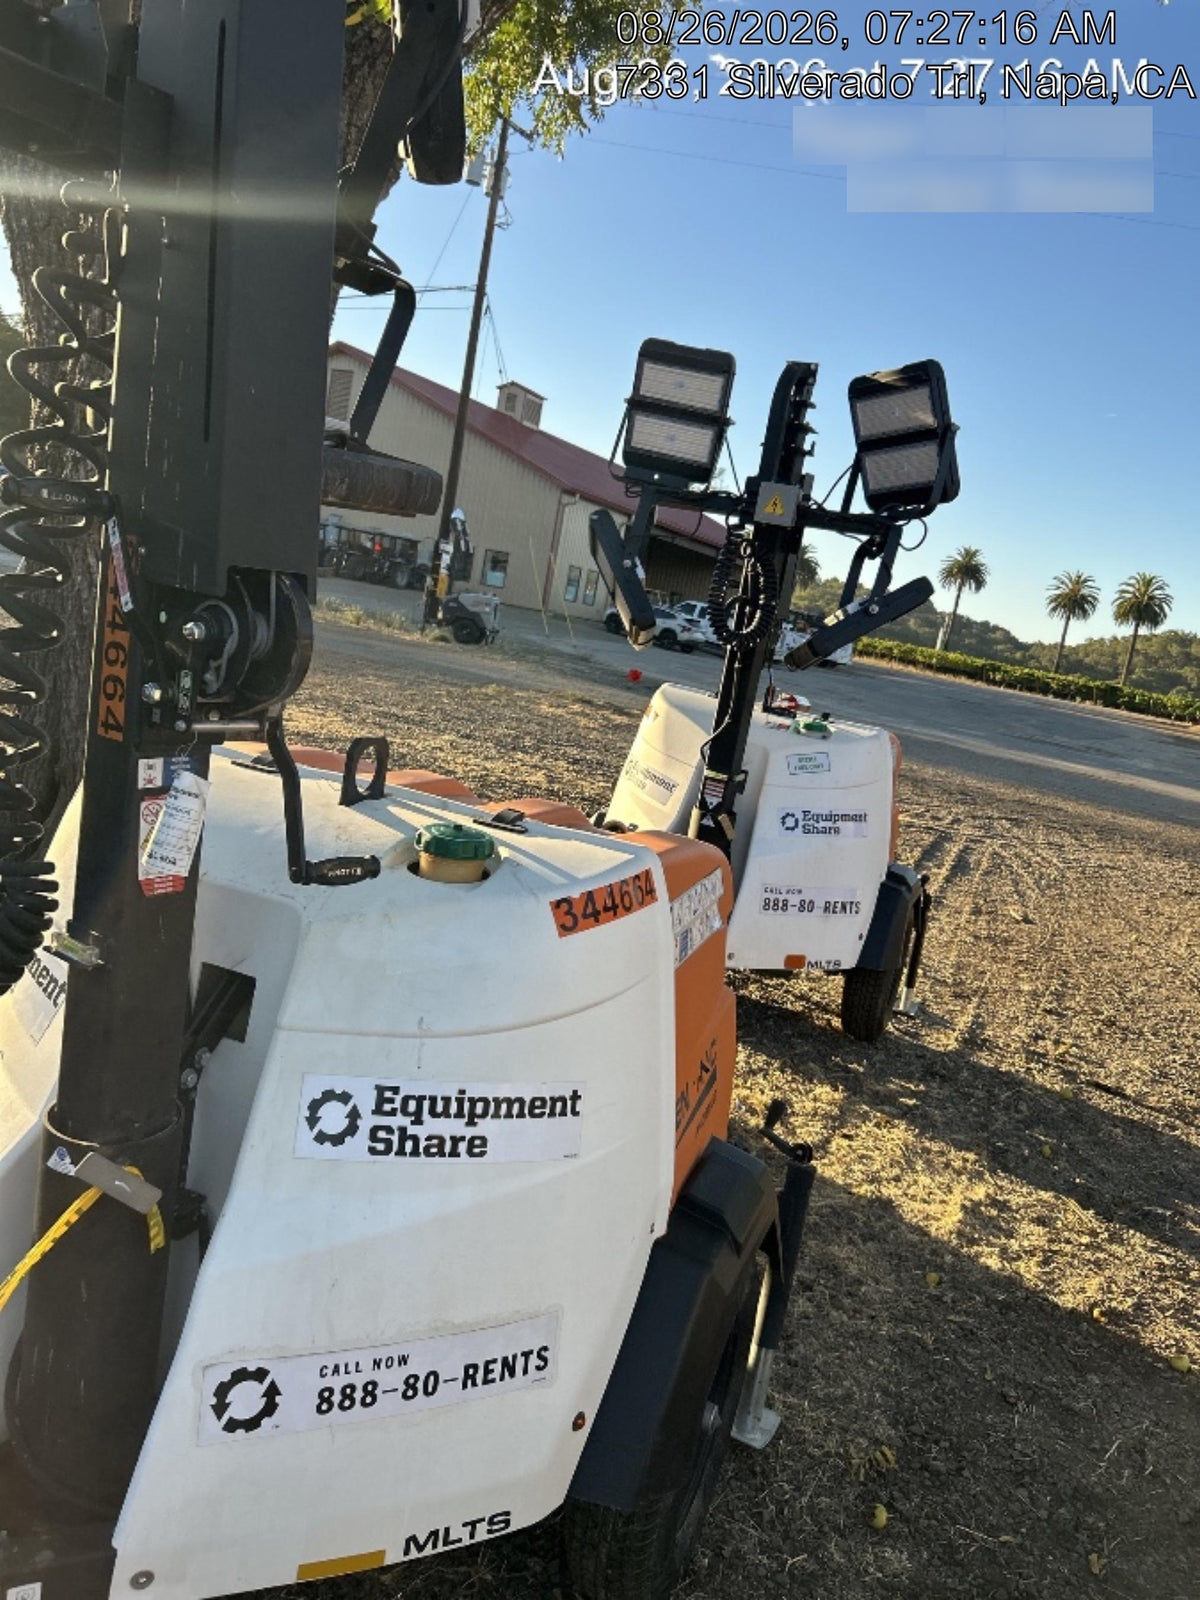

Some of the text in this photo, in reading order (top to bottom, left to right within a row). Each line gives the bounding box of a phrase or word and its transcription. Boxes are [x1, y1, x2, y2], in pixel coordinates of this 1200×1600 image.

[801, 810, 868, 826] Equipment
[802, 823, 840, 835] Share
[554, 868, 657, 932] 344664
[762, 897, 862, 915] 888-80-RENTS
[371, 1084, 582, 1127] Equipment
[367, 1125, 488, 1158] Share
[315, 1345, 550, 1416] 888-80-RENTS
[319, 1354, 410, 1379] CALL NOW
[402, 1510, 511, 1556] MLTS
